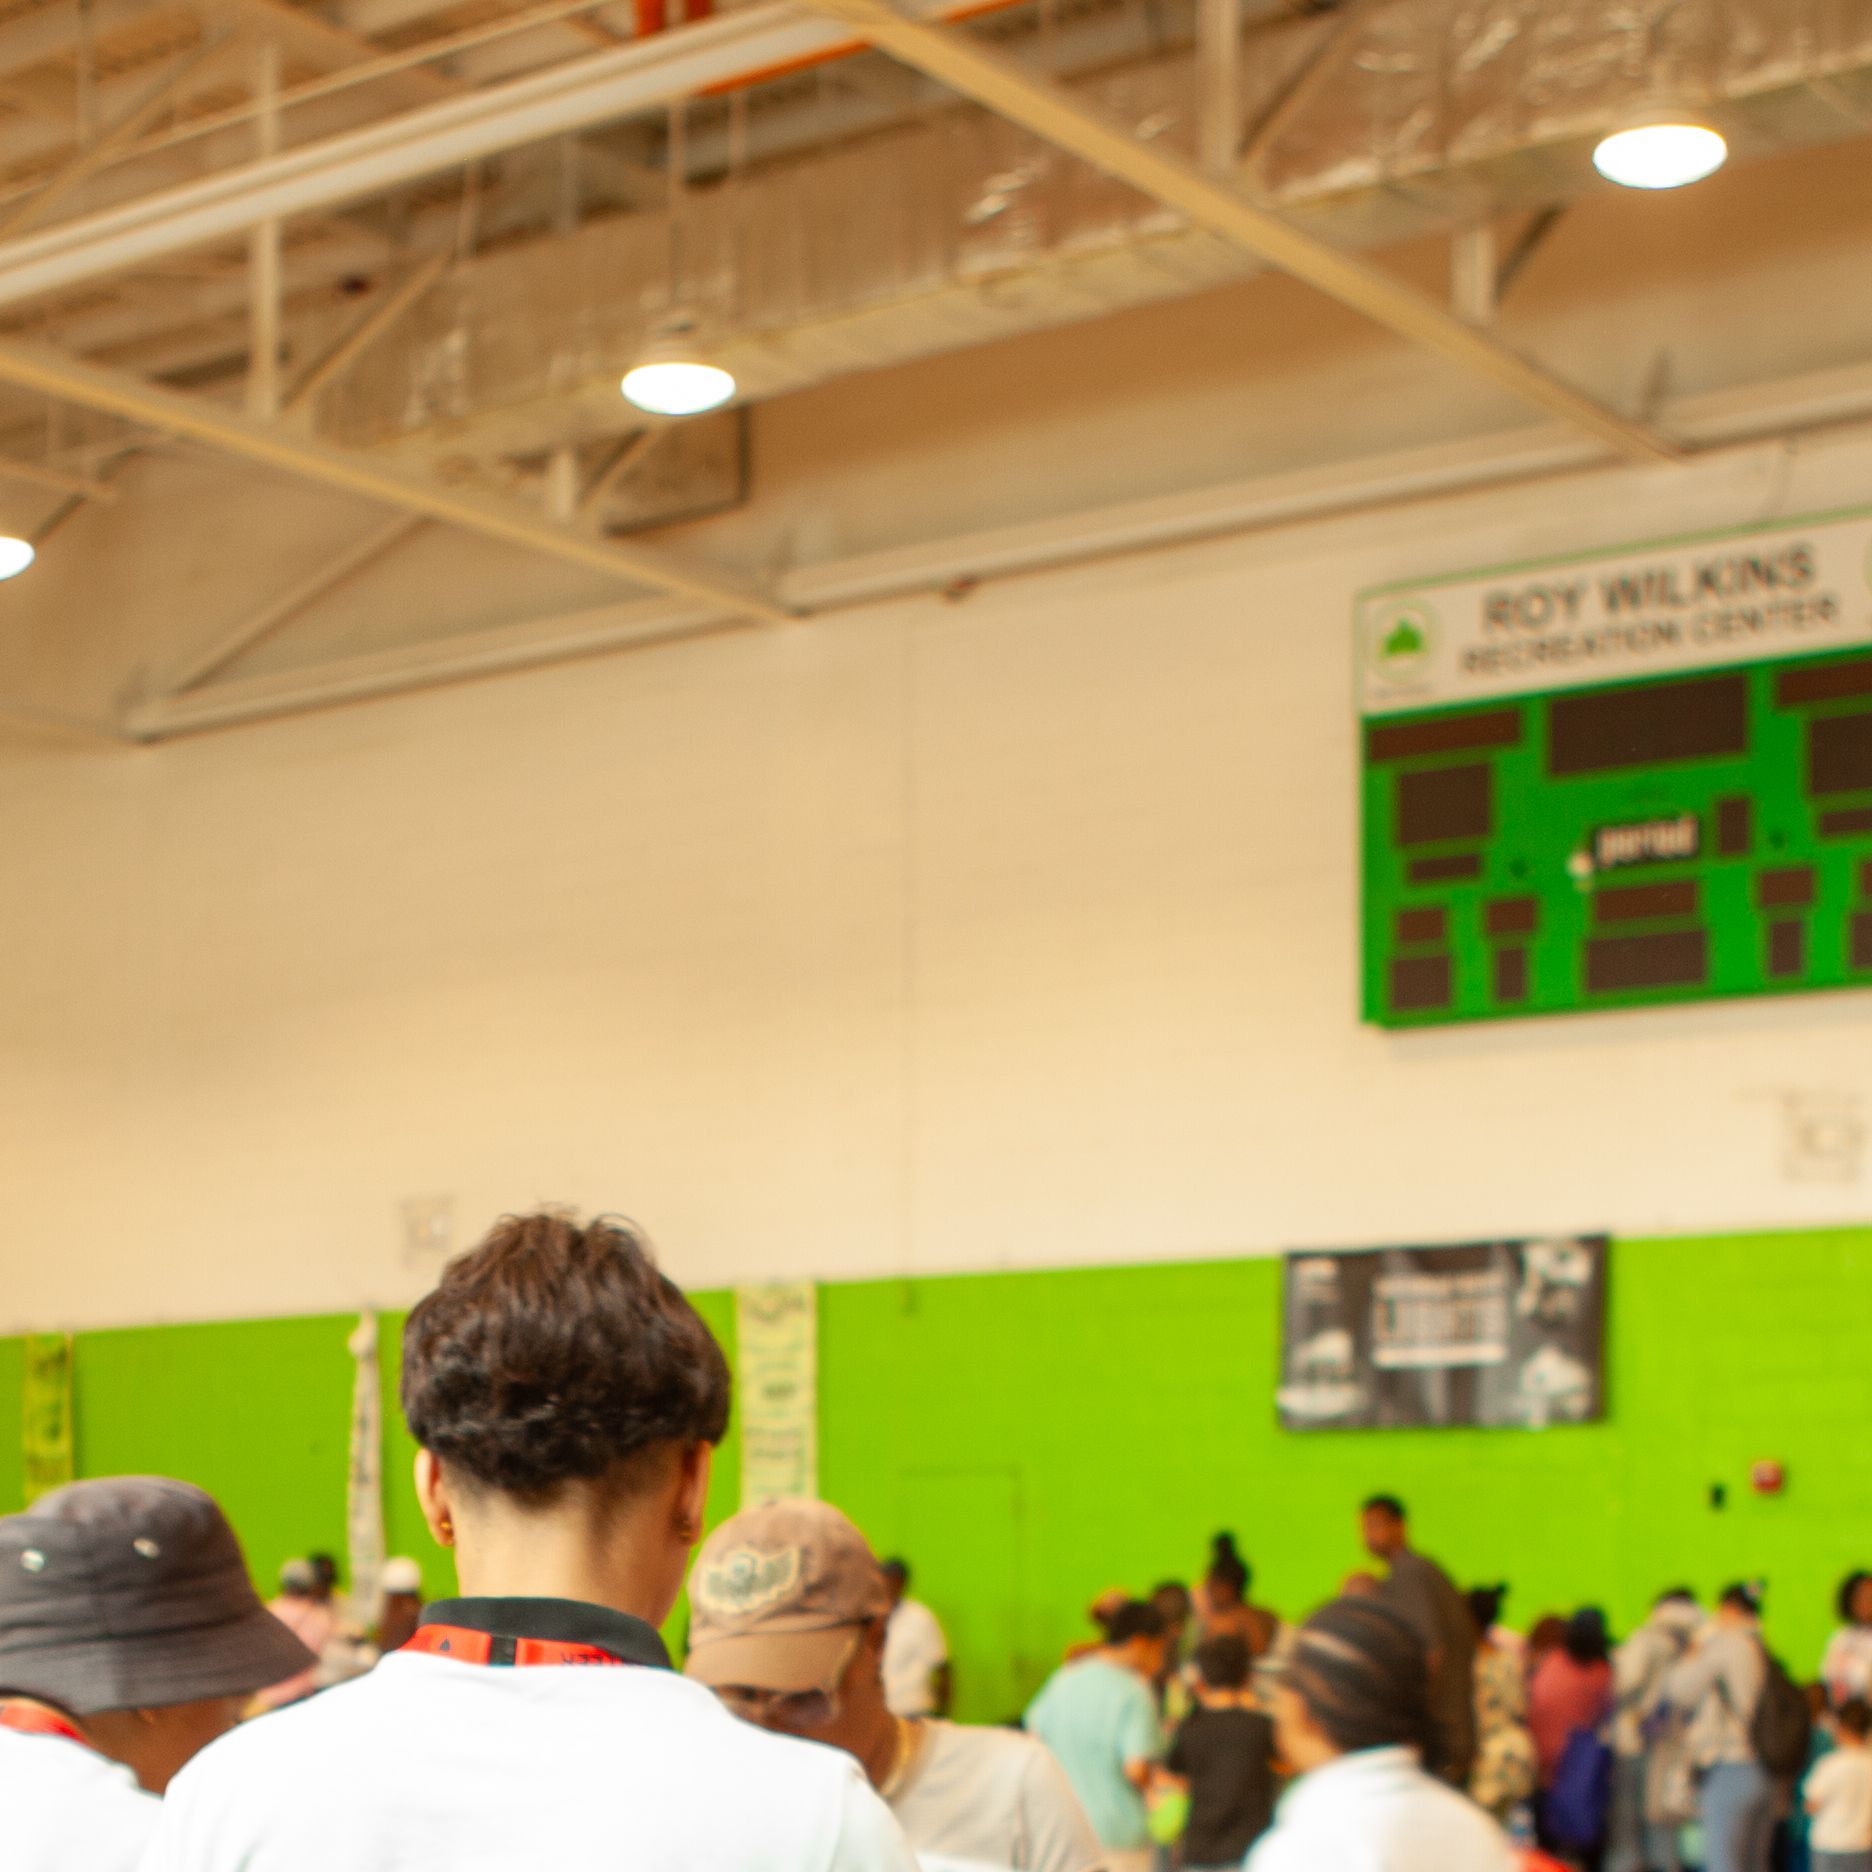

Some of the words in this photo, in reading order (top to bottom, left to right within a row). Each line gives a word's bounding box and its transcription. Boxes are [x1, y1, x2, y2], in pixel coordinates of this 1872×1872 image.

[1483, 579, 1587, 635] ROY
[1603, 541, 1817, 611] WILKINS
[1459, 621, 1682, 678] RECREATION
[1693, 594, 1840, 652] CENTER
